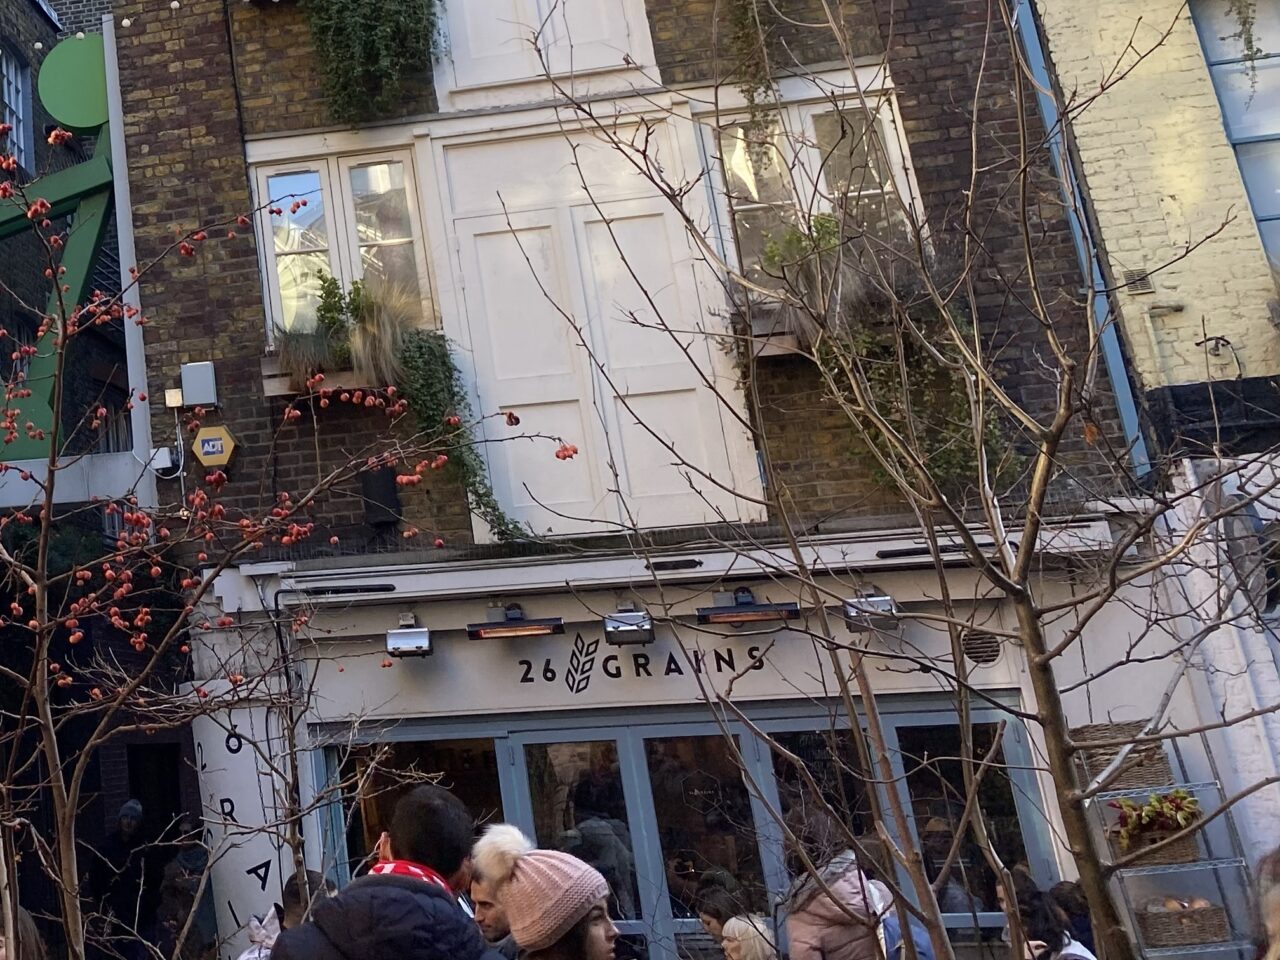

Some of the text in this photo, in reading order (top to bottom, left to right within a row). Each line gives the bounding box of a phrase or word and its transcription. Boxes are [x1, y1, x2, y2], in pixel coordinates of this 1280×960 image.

[202, 440, 223, 452] ADT
[518, 645, 765, 683] 26 GRAINS
